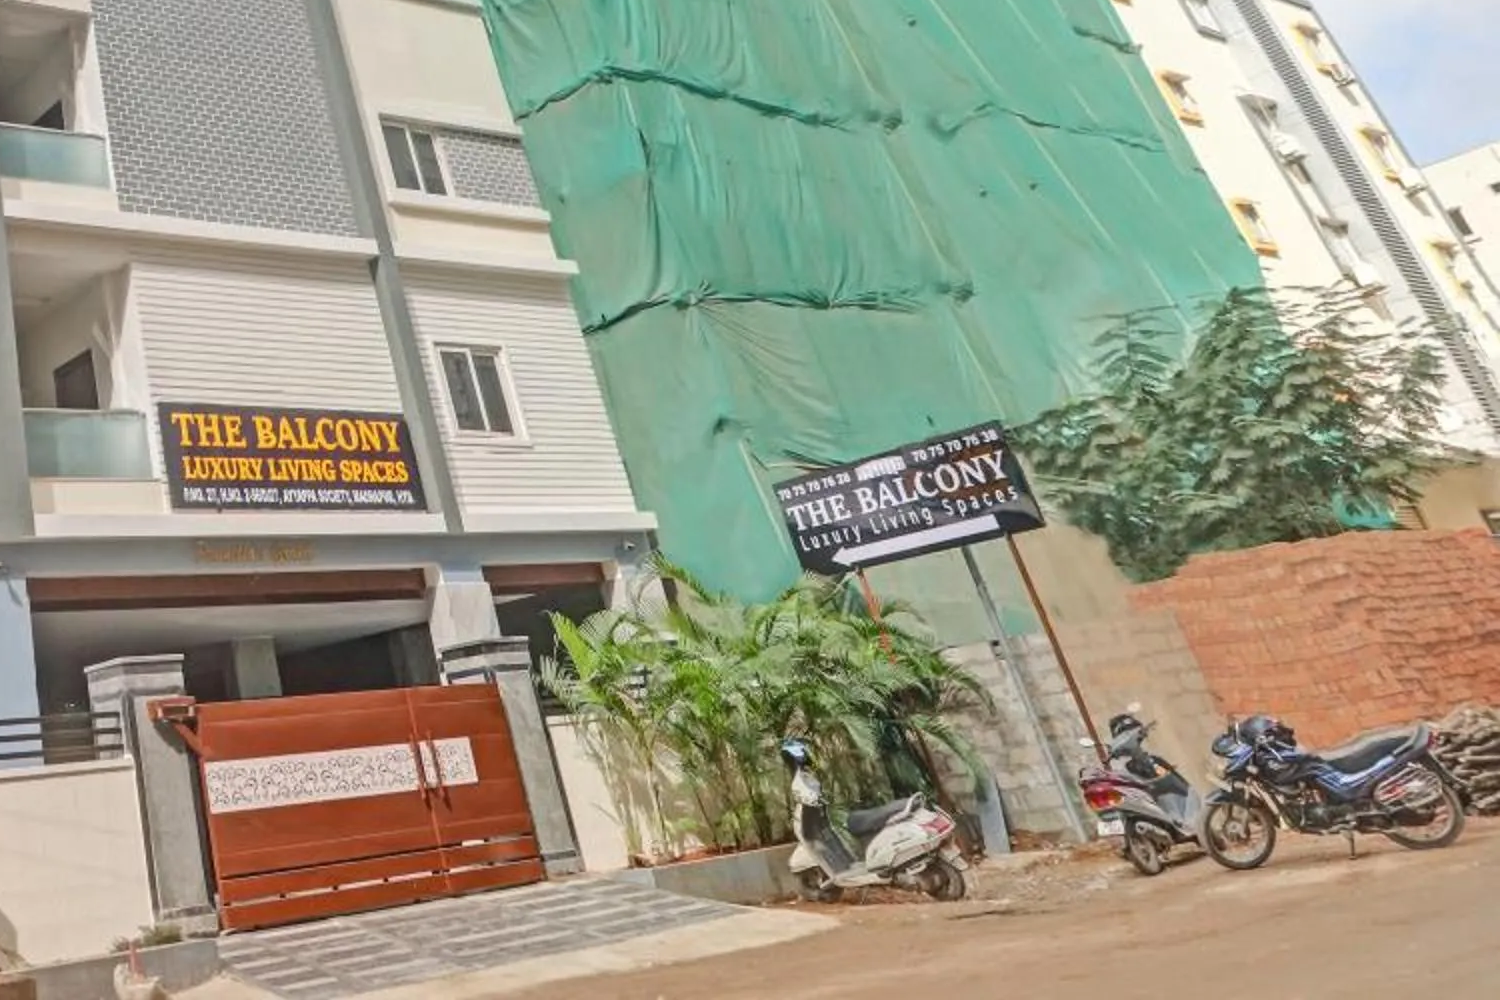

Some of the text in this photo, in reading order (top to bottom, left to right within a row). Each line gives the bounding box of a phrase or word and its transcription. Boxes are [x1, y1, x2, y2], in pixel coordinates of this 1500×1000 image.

[171, 412, 399, 452] THE BALCONY
[182, 455, 410, 484] LUXURY LIVING SPACES
[911, 449, 927, 462] 70
[786, 494, 852, 531] THE
[854, 449, 1009, 515] BALCONY
[801, 485, 1019, 552] Luxury Living Spaces
